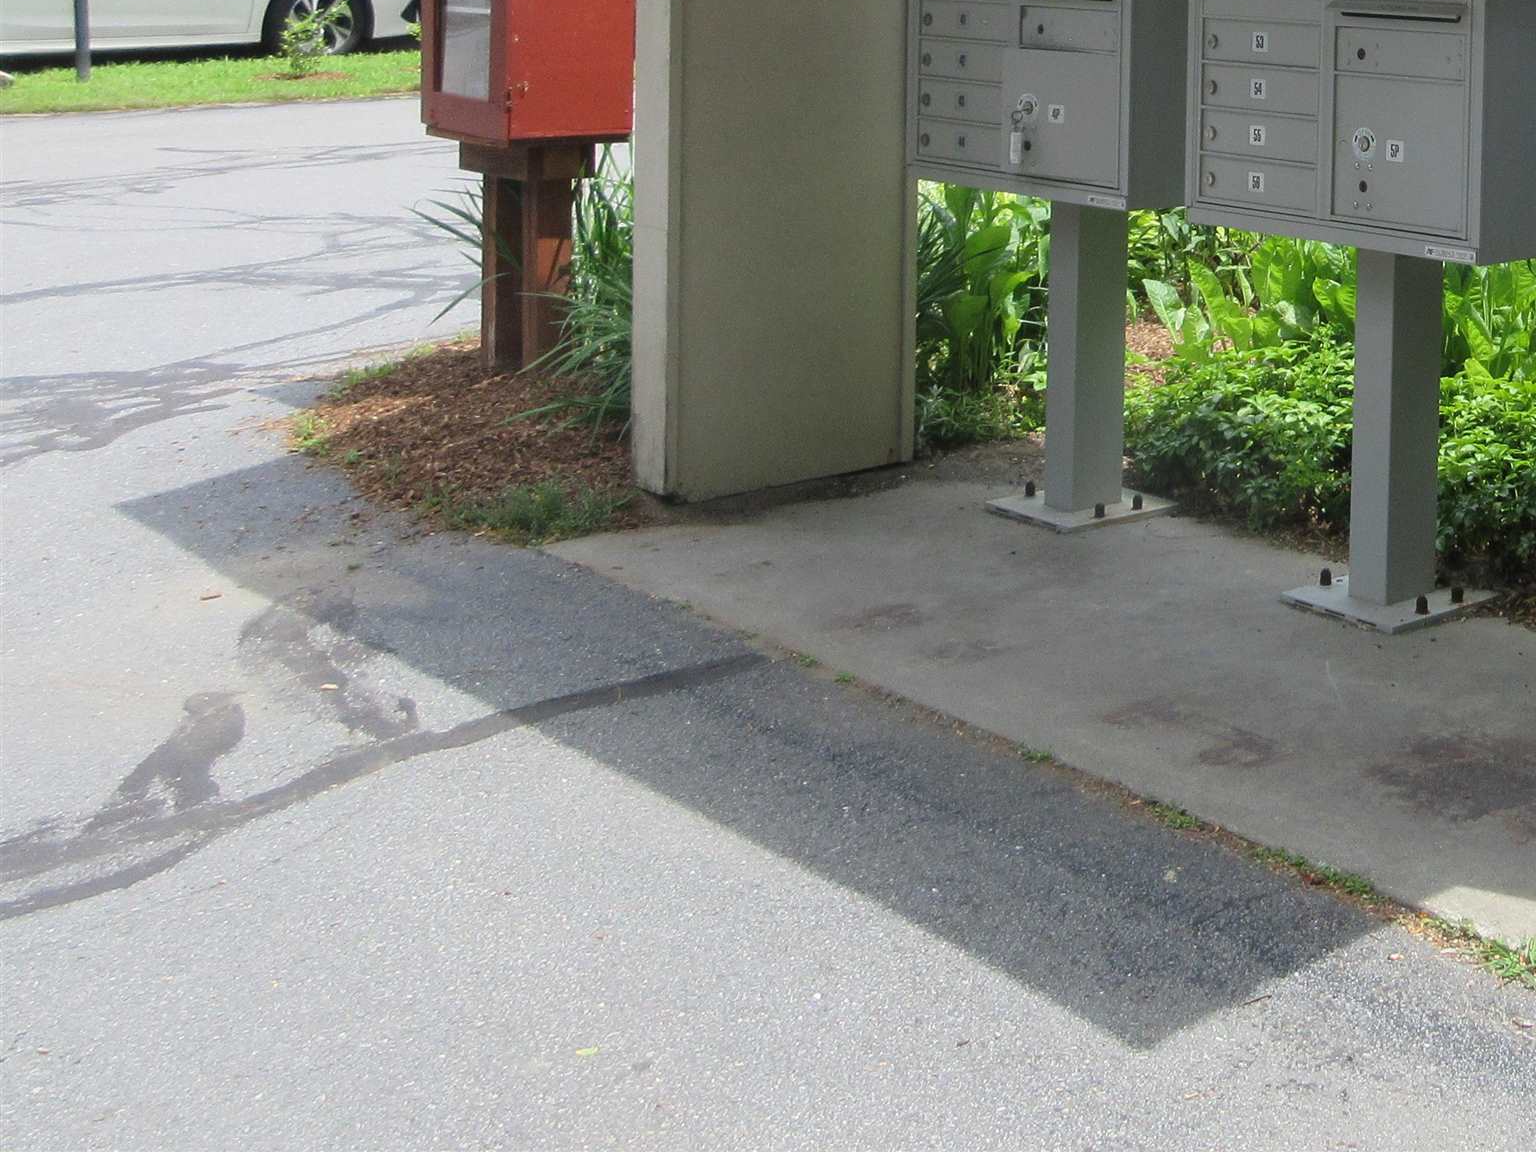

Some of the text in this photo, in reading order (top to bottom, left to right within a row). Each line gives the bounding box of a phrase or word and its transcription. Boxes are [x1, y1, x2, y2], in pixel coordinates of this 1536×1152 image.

[1255, 34, 1265, 49] 53
[1253, 81, 1263, 96] 54
[1253, 128, 1262, 143] 55
[1390, 143, 1400, 158] 5P
[1252, 175, 1261, 190] 56
